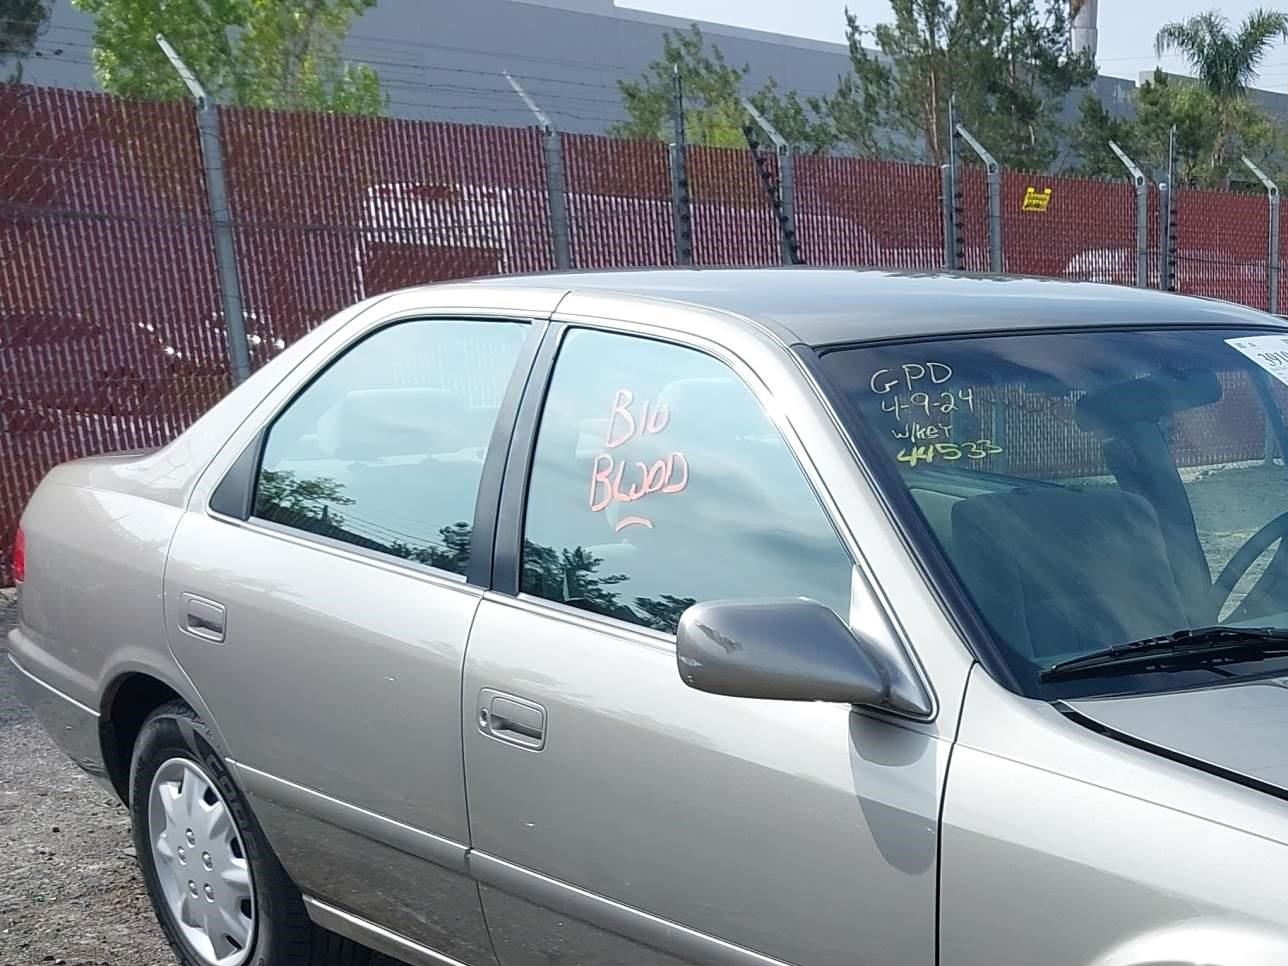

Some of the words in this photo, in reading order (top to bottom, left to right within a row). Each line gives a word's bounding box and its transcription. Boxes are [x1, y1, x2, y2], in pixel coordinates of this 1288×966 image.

[870, 362, 953, 394] GPD
[881, 388, 974, 421] 4-9-24
[896, 439, 1003, 467] 44533
[589, 451, 689, 512] BLOOD
